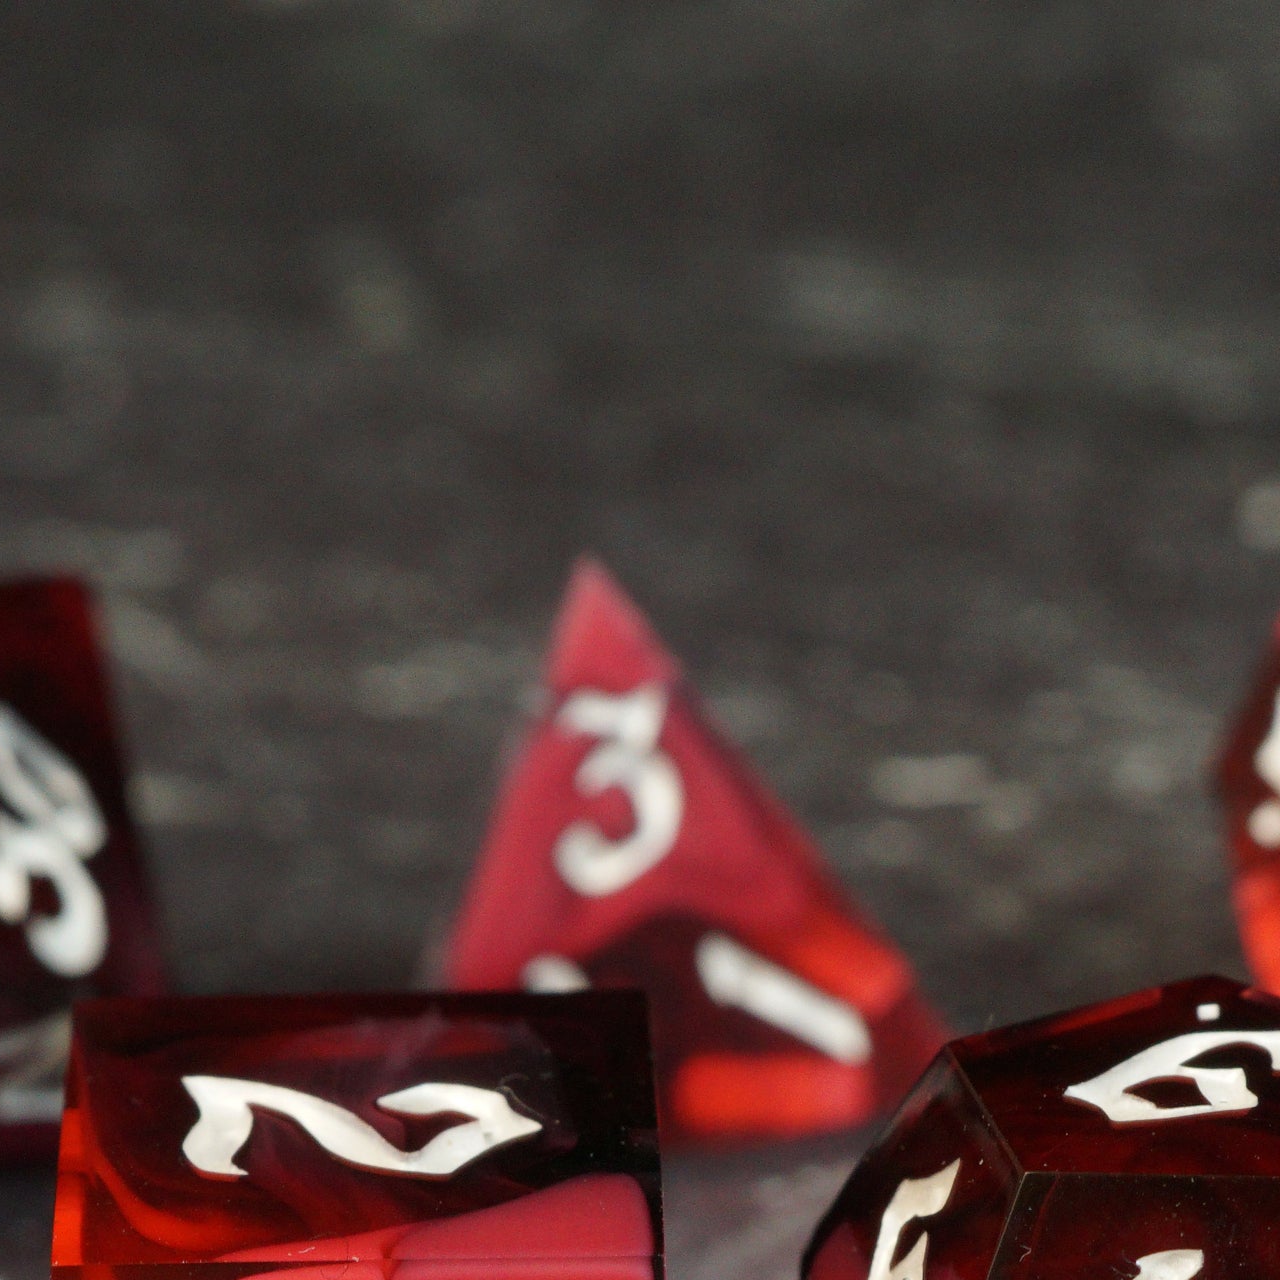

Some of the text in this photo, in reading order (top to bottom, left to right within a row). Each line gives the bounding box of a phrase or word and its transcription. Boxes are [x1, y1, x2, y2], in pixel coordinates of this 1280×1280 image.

[554, 685, 685, 897] 3
[696, 932, 872, 1066] 1
[181, 1074, 544, 1177] 2
